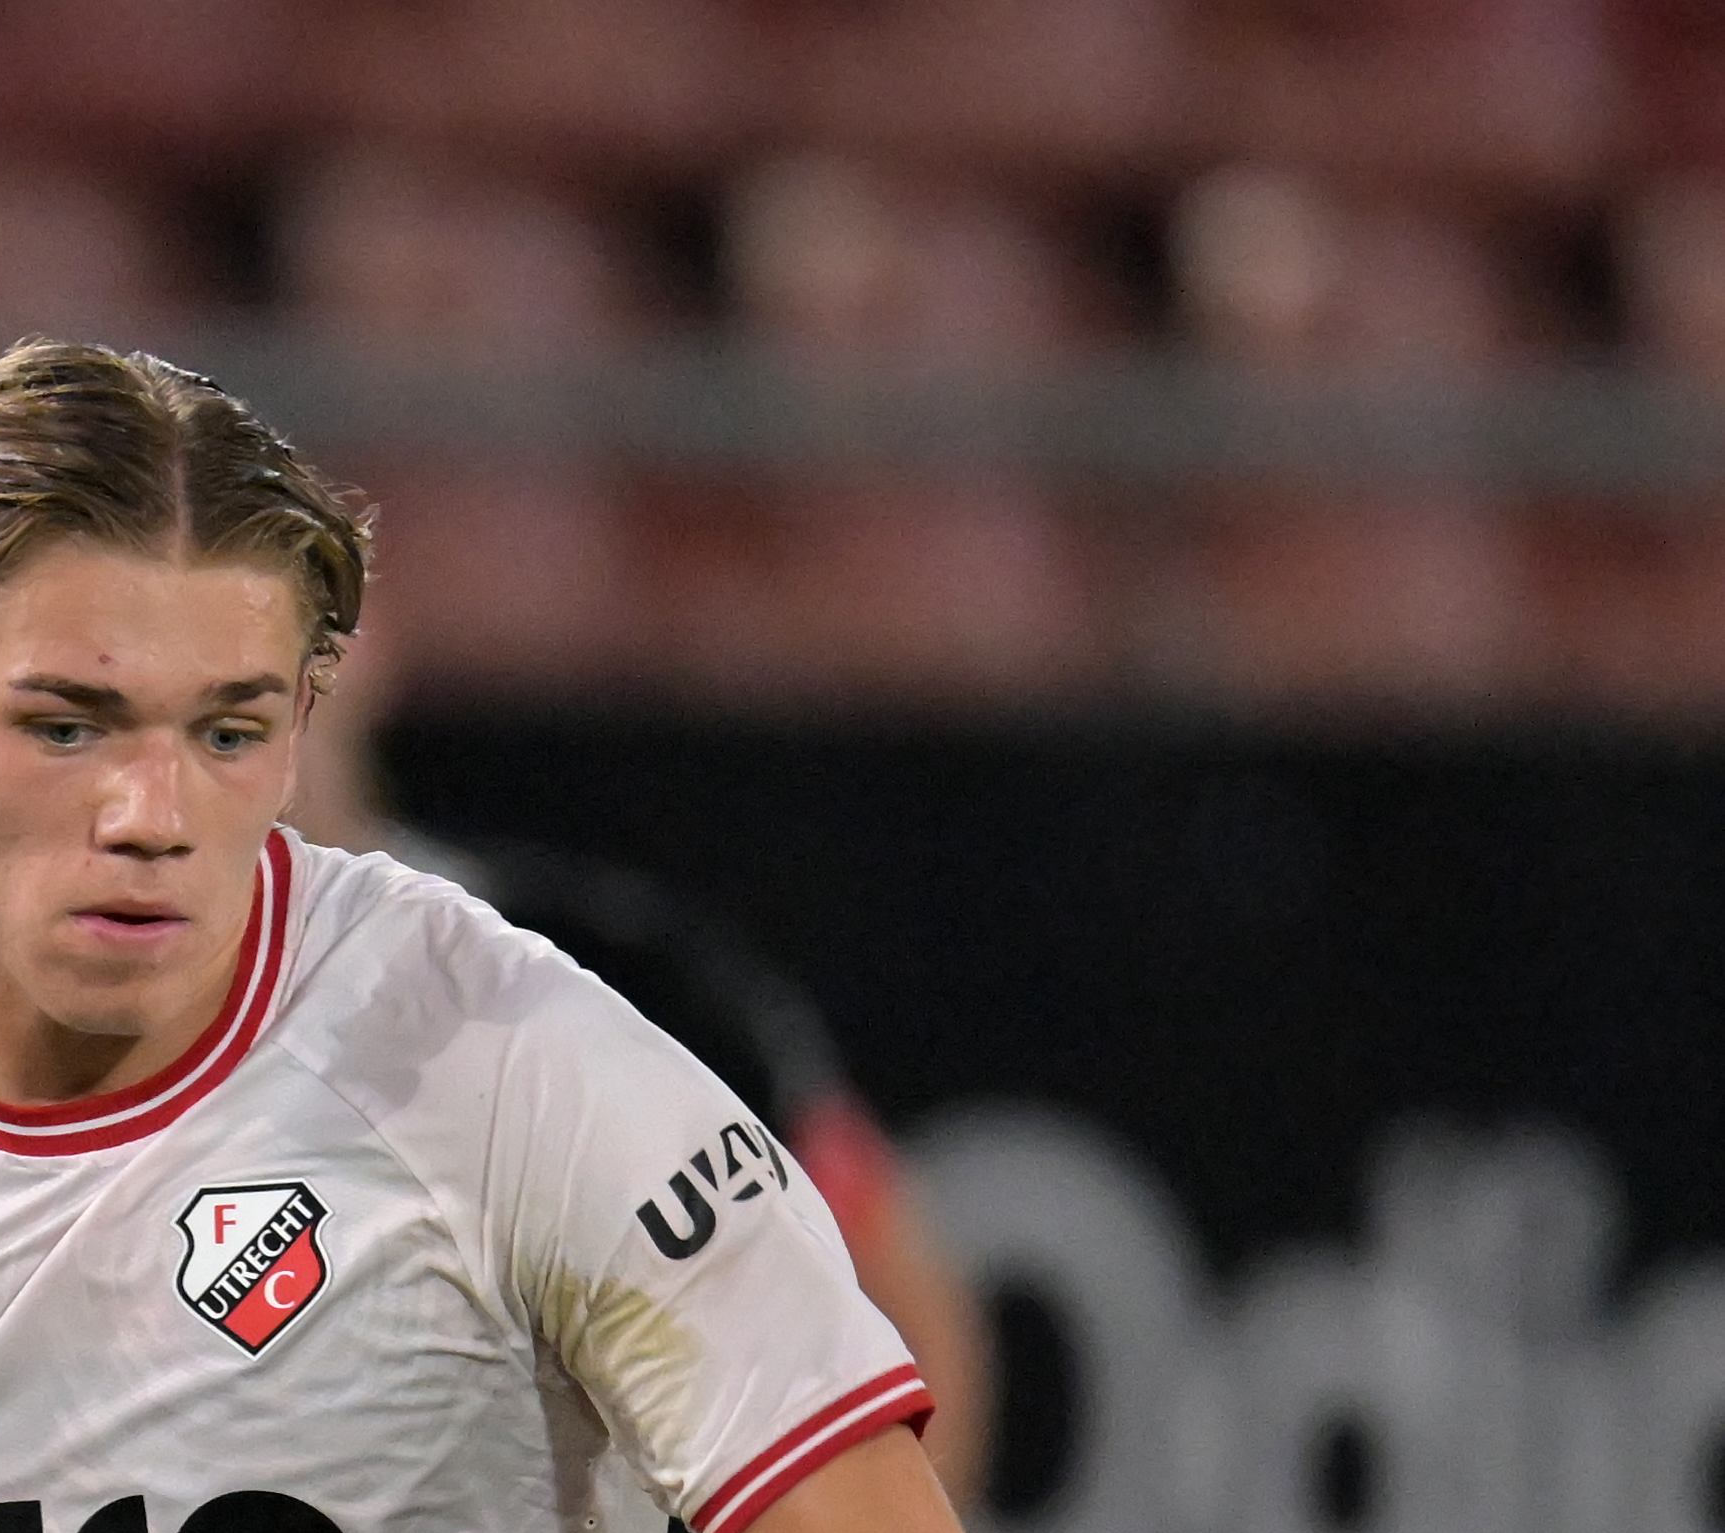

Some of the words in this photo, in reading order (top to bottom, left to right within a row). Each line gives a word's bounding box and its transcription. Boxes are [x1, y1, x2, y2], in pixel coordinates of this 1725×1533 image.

[214, 1203, 237, 1245] F
[198, 1193, 314, 1320] UTRECHT
[264, 1270, 296, 1309] C
